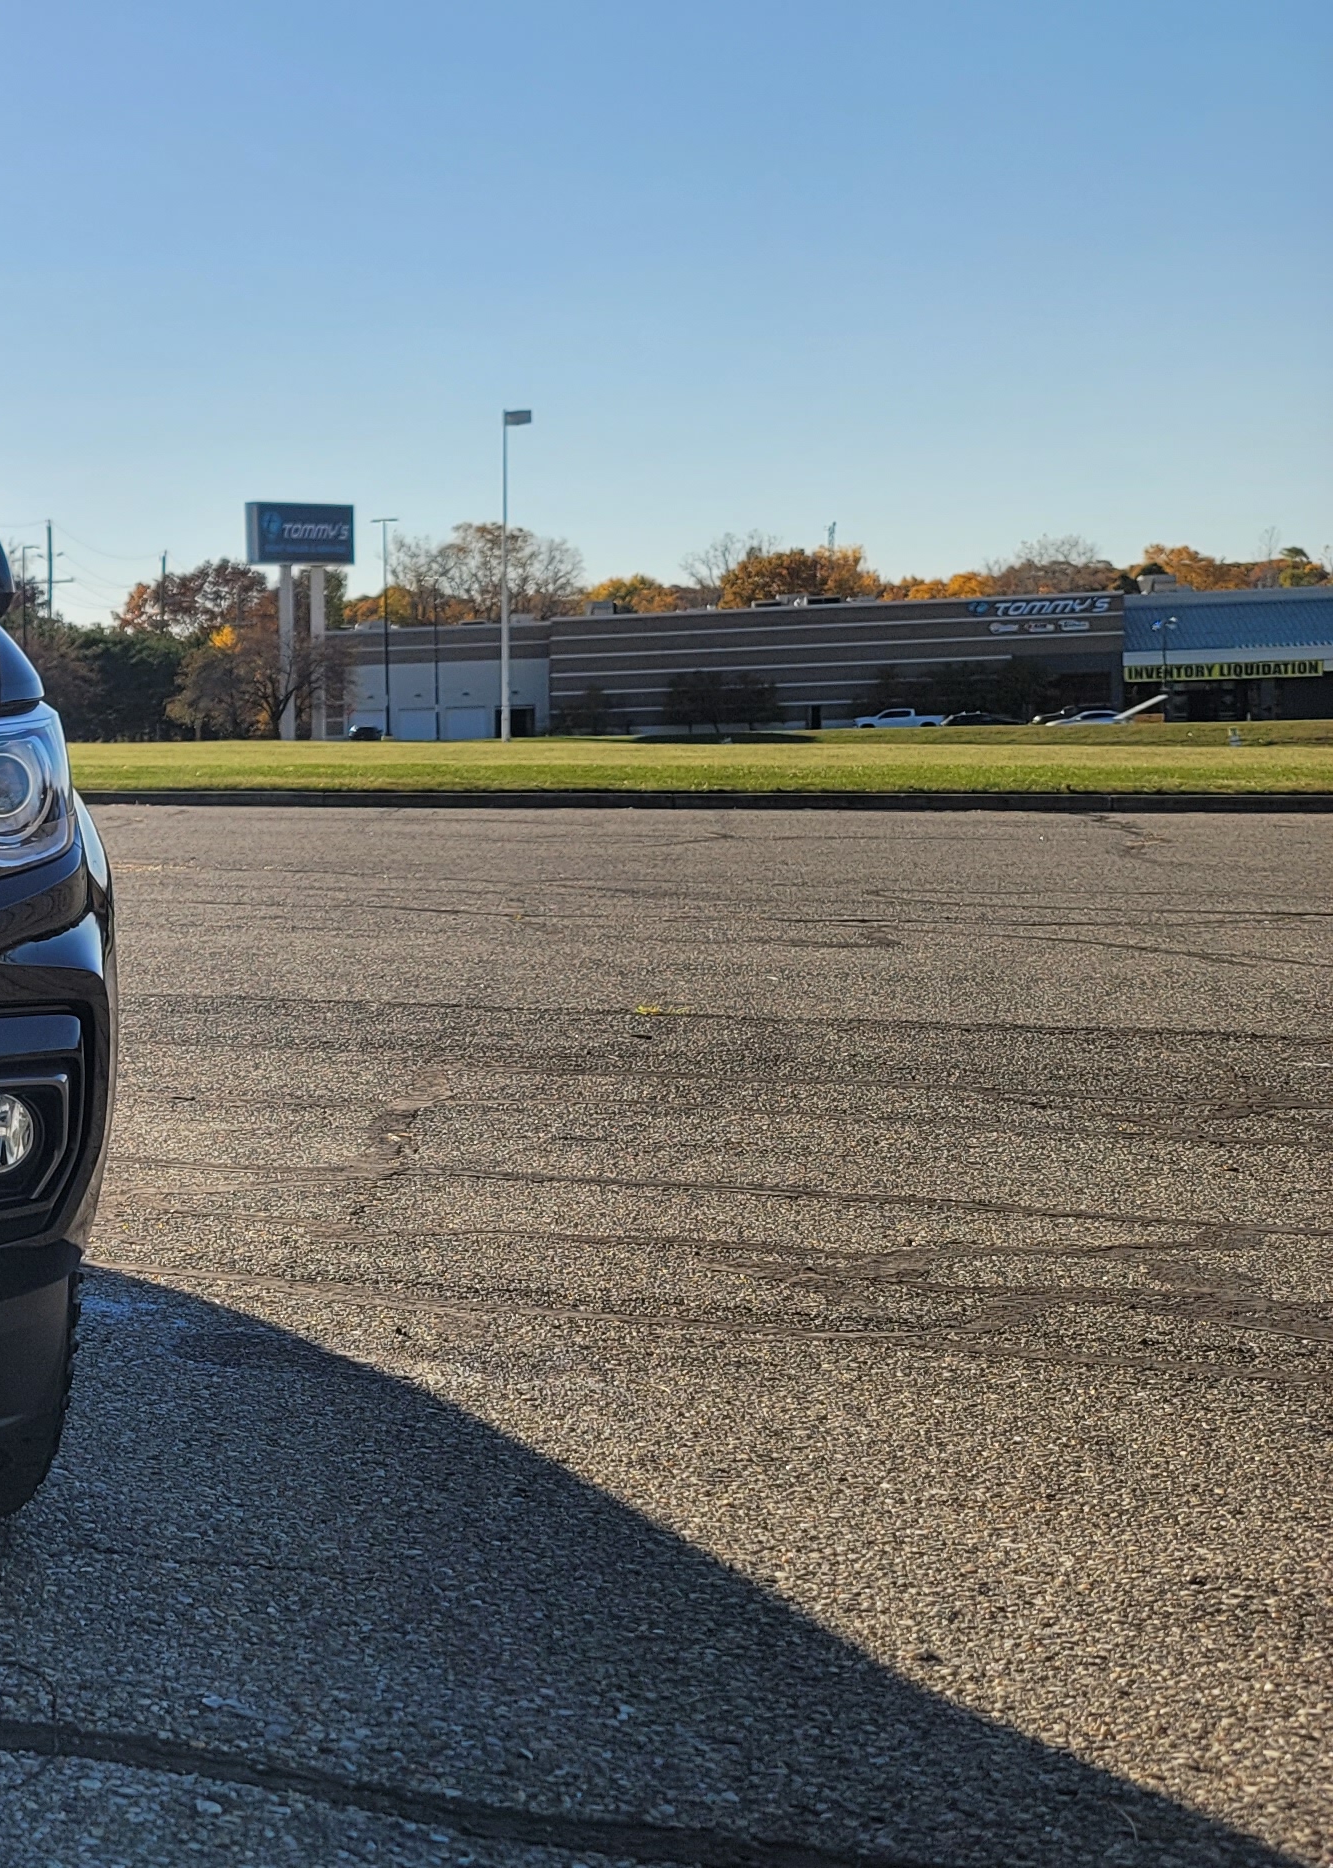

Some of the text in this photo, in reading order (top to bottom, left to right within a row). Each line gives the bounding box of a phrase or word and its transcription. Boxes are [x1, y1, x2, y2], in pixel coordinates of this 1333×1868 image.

[282, 523, 350, 540] TOMMY'S
[994, 597, 1111, 616] TOMMY'S
[1127, 661, 1320, 680] INVENTORY LIQUIDATION
